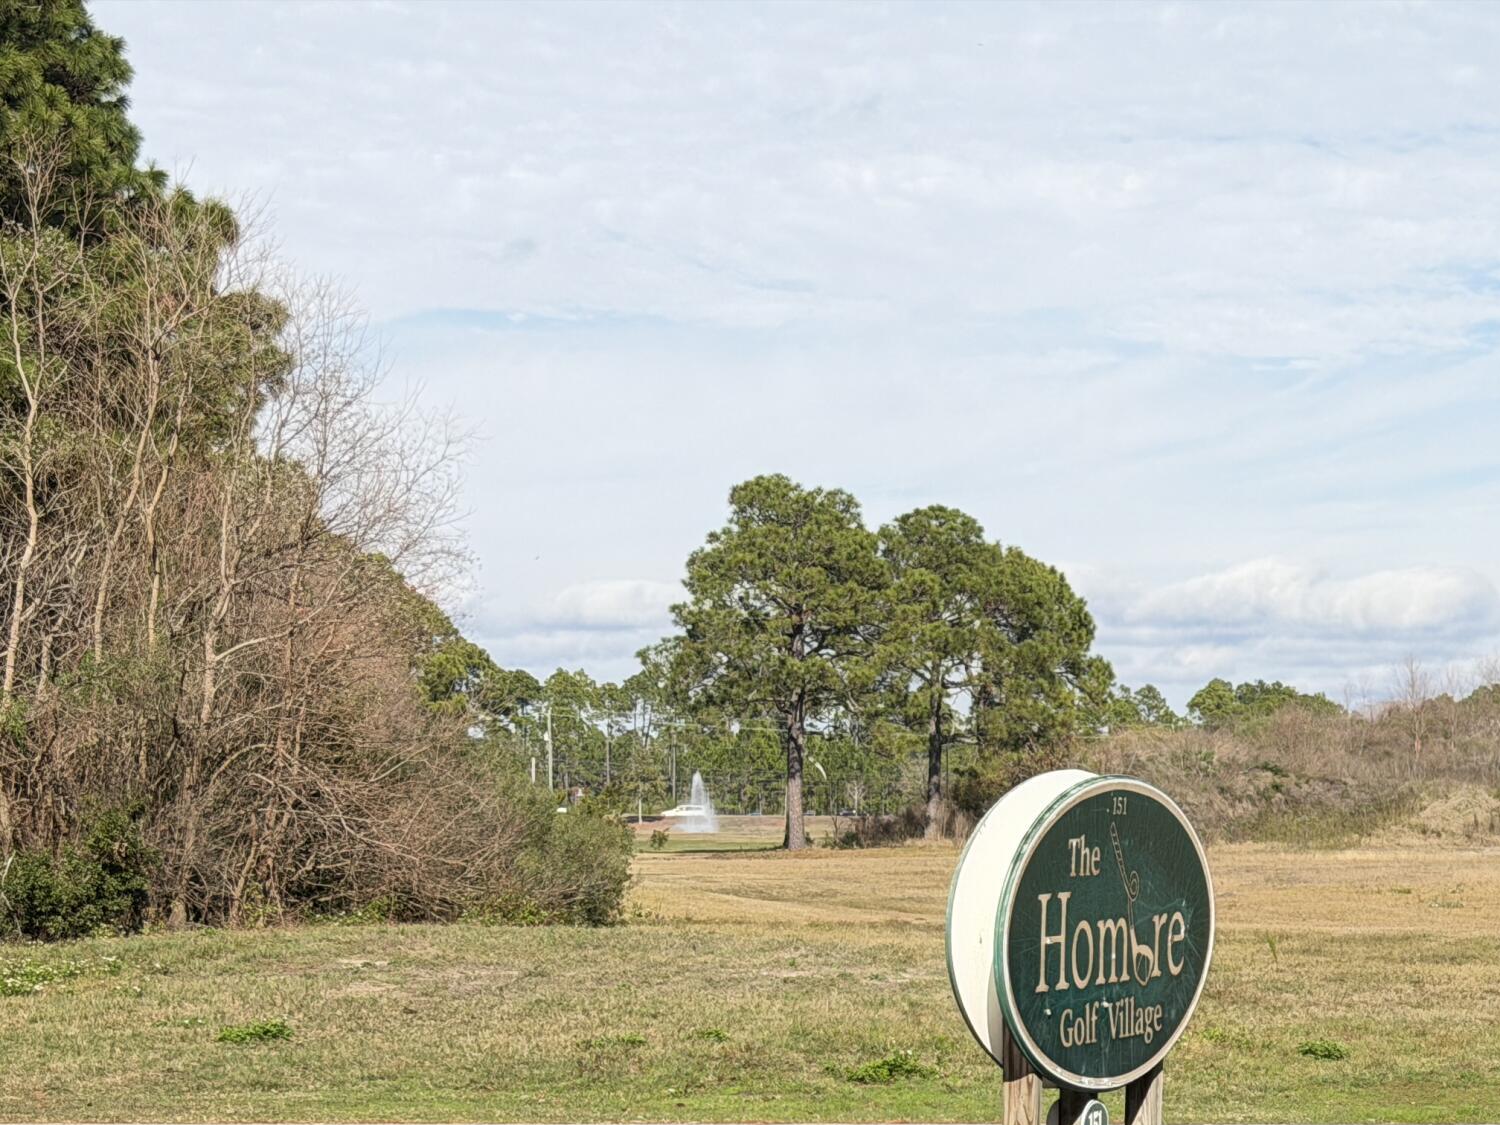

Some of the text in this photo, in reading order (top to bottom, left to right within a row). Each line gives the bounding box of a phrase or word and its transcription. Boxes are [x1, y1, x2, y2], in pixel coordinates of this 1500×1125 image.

[1112, 797, 1128, 816] 151
[1068, 834, 1101, 878] The
[1035, 891, 1186, 993] Hombre
[1060, 997, 1163, 1048] Golf Village
